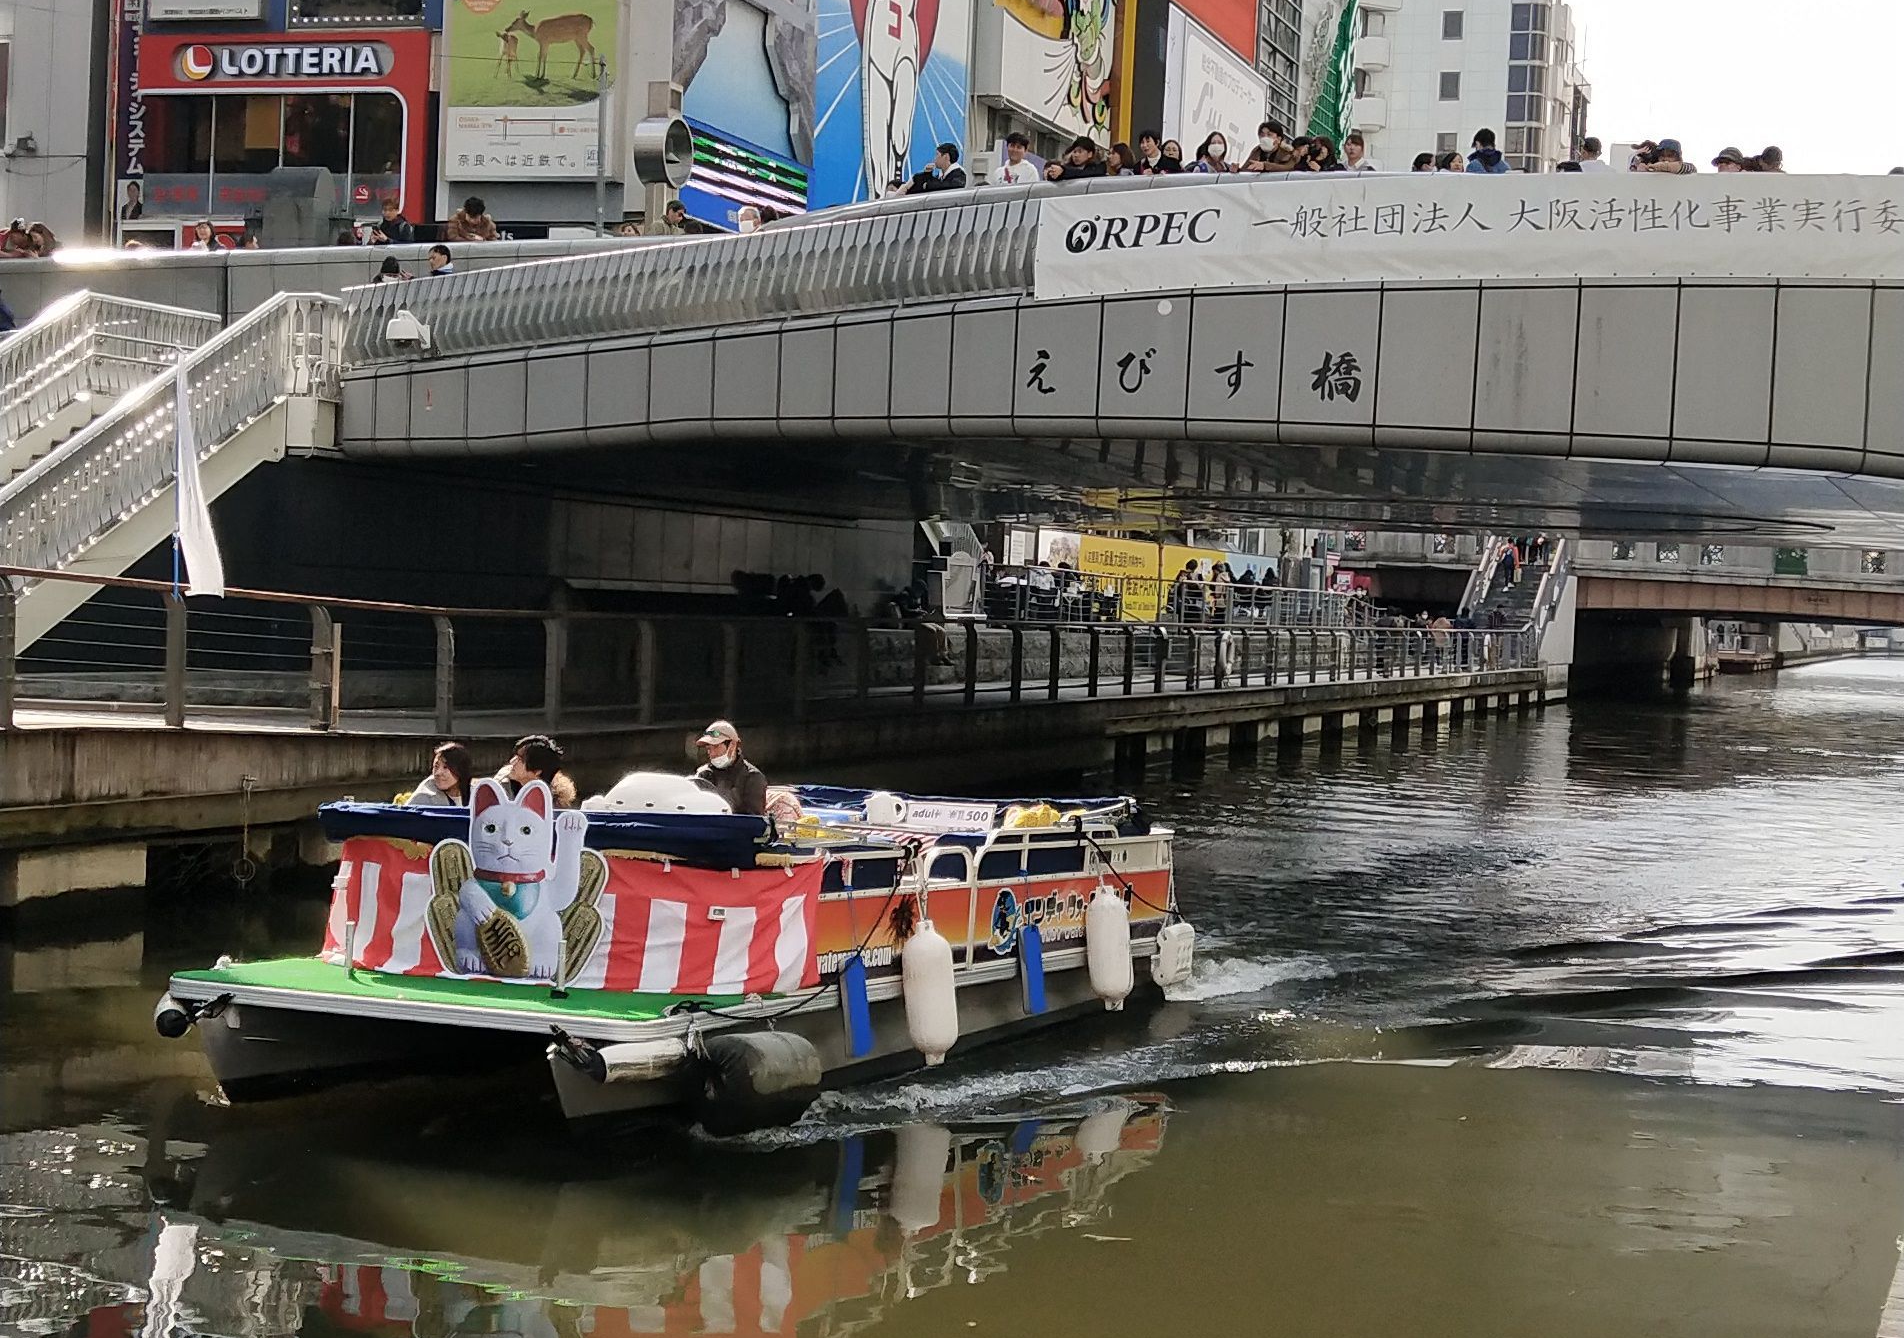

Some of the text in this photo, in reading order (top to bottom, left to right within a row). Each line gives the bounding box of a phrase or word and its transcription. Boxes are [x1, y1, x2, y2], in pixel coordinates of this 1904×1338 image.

[220, 46, 378, 75] LOTTERIA
[457, 154, 576, 168] 奈良へは近鉄で。
[1252, 201, 1492, 237] 一般社団法人
[1508, 198, 1904, 232] 大阪活性化事業実行委
[1026, 347, 1364, 405] えびす橋
[912, 810, 941, 823] adult
